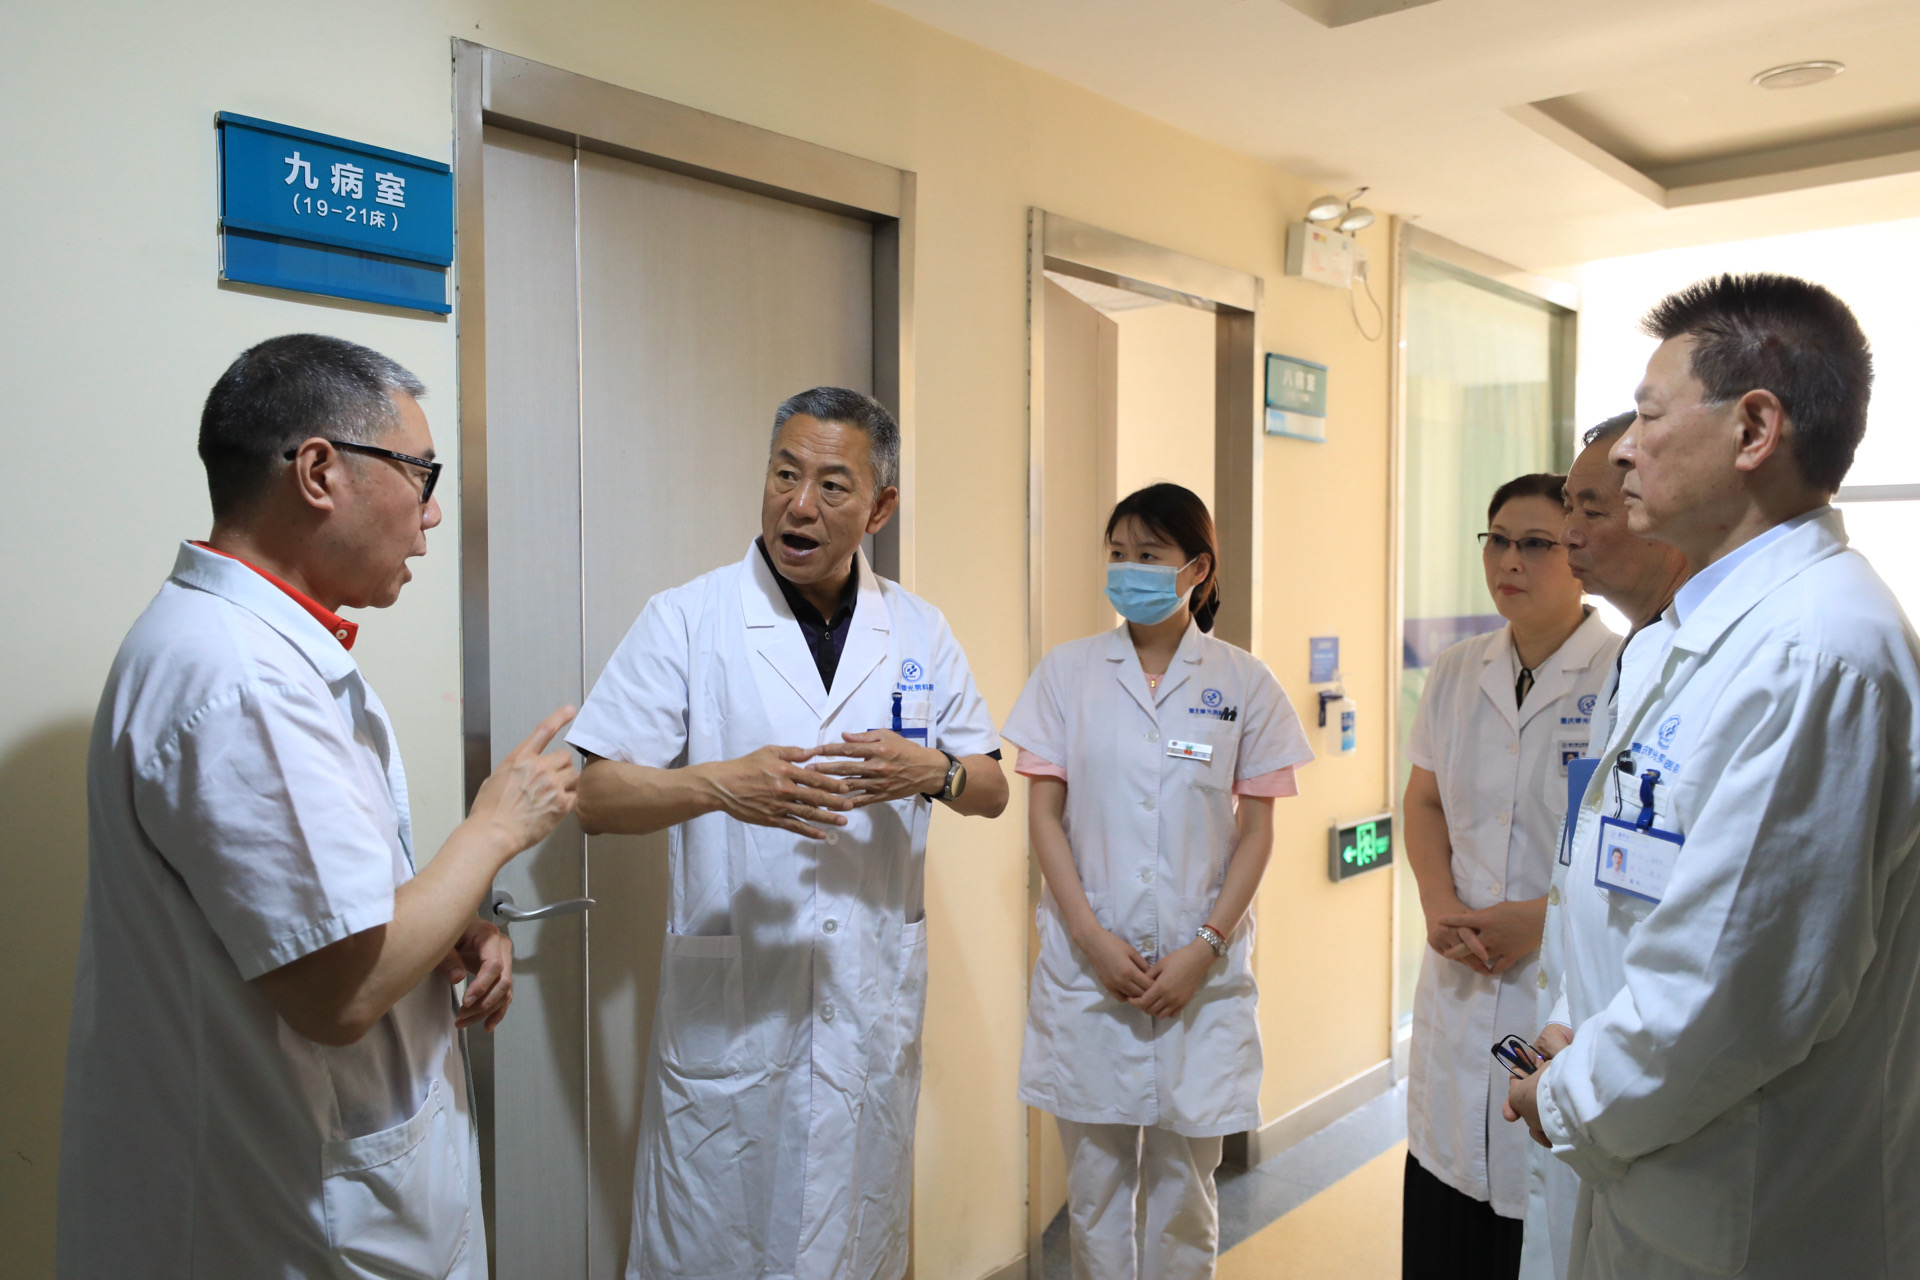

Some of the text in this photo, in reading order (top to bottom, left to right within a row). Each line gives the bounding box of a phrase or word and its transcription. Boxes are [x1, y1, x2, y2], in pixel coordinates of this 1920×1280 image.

[284, 151, 405, 208] 九病室
[293, 193, 398, 232] (19-21床)
